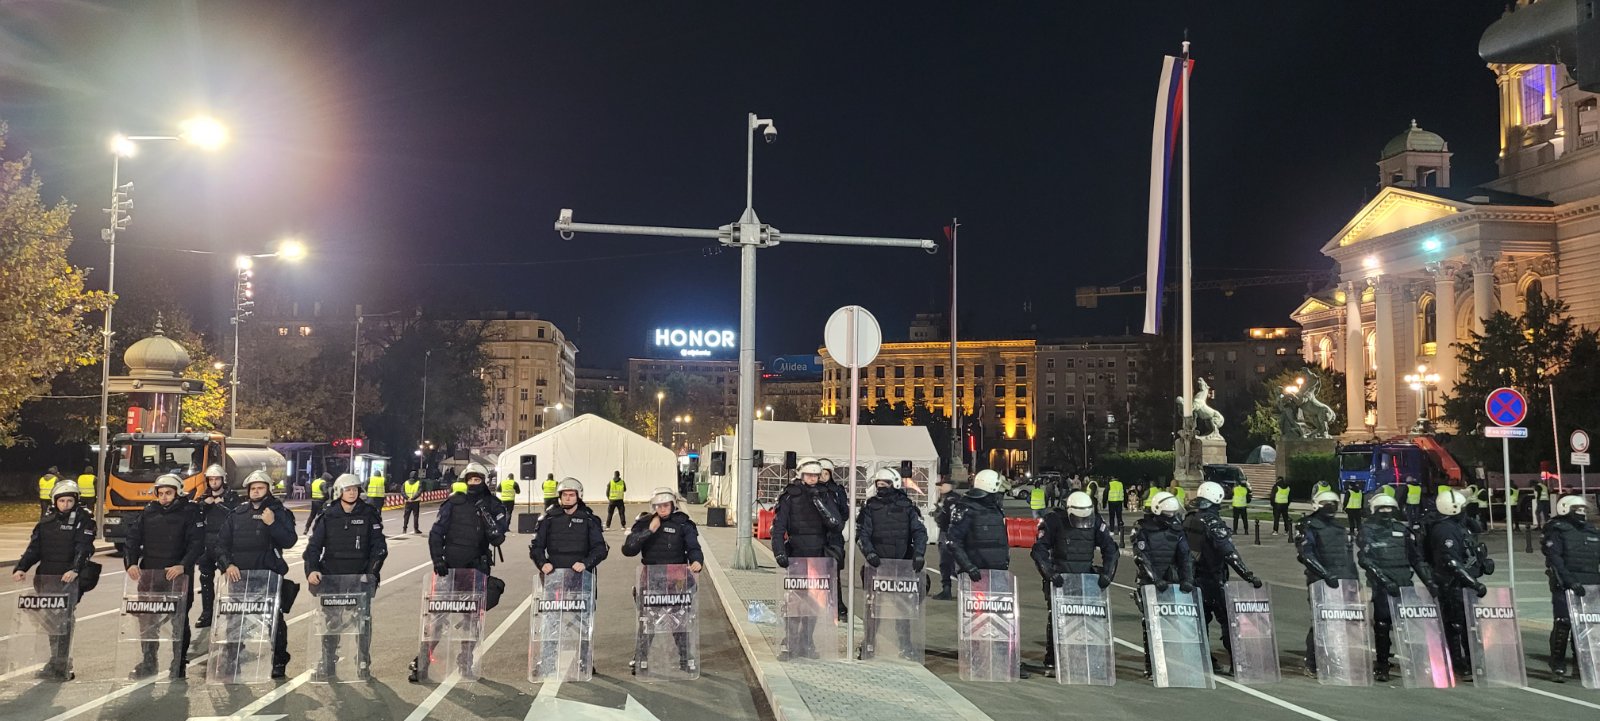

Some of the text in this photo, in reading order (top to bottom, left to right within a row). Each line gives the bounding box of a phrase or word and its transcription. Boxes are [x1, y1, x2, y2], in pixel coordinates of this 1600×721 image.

[655, 329, 735, 347] HONOR
[781, 363, 808, 371] Midea
[785, 579, 829, 589] ПОЛИЦИЈА
[874, 580, 918, 592] POLICIJA
[19, 597, 65, 608] POLICIJA
[644, 594, 691, 605] ПОЛИЦИЈА
[127, 602, 175, 612] ПОЛИЦИЈА
[221, 602, 269, 613] ПОЛИЦИЈА
[429, 601, 476, 612] ПОЛИЦИЈА
[539, 600, 586, 611] ПОЛИЦИЈА
[967, 601, 1012, 612] ПОЛИЦИЈА
[1061, 604, 1105, 616] ПОЛИЦИЈА
[1154, 605, 1198, 616] POLICIJA
[1322, 610, 1364, 620] ПОЛИЦИЈА
[1400, 608, 1437, 618] POLICIJA
[1475, 608, 1514, 618] POLICIJA
